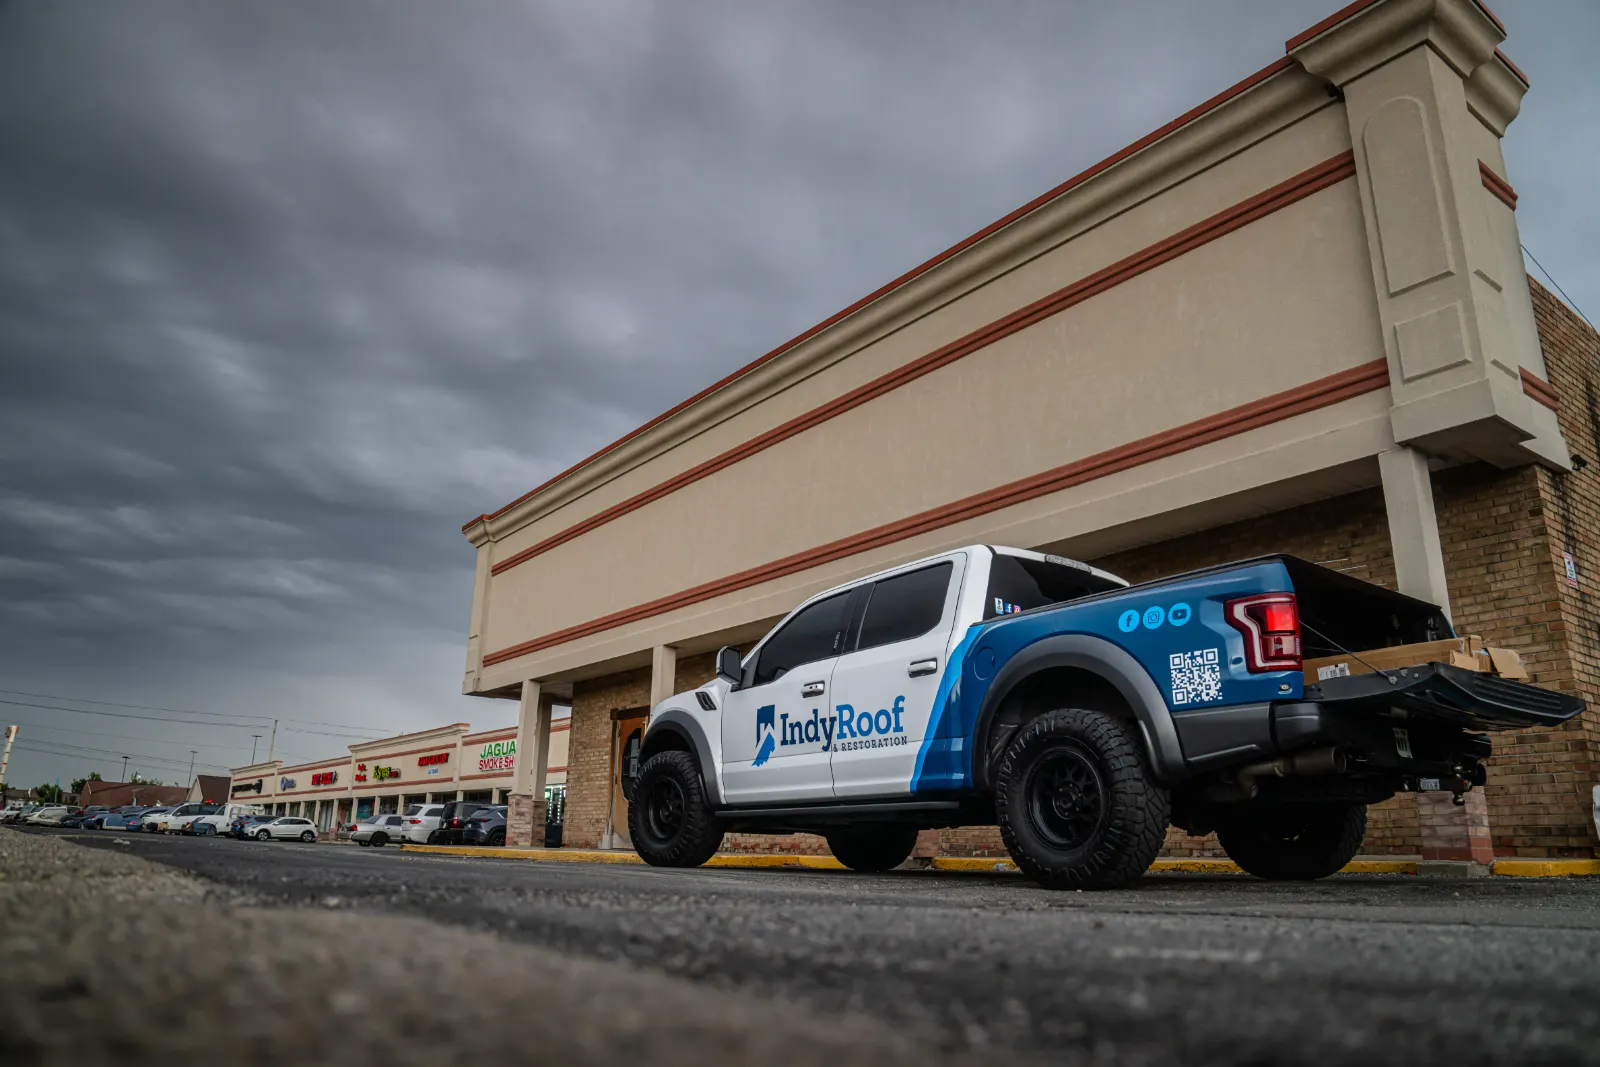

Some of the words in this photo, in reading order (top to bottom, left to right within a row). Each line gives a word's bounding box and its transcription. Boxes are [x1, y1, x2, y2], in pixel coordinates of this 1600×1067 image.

[780, 695, 905, 752] IndyRoof
[480, 740, 517, 759] JAGUA
[833, 743, 839, 752] &
[841, 736, 908, 752] RESTORATION
[479, 757, 503, 771] SMOKE
[504, 756, 515, 768] SH
